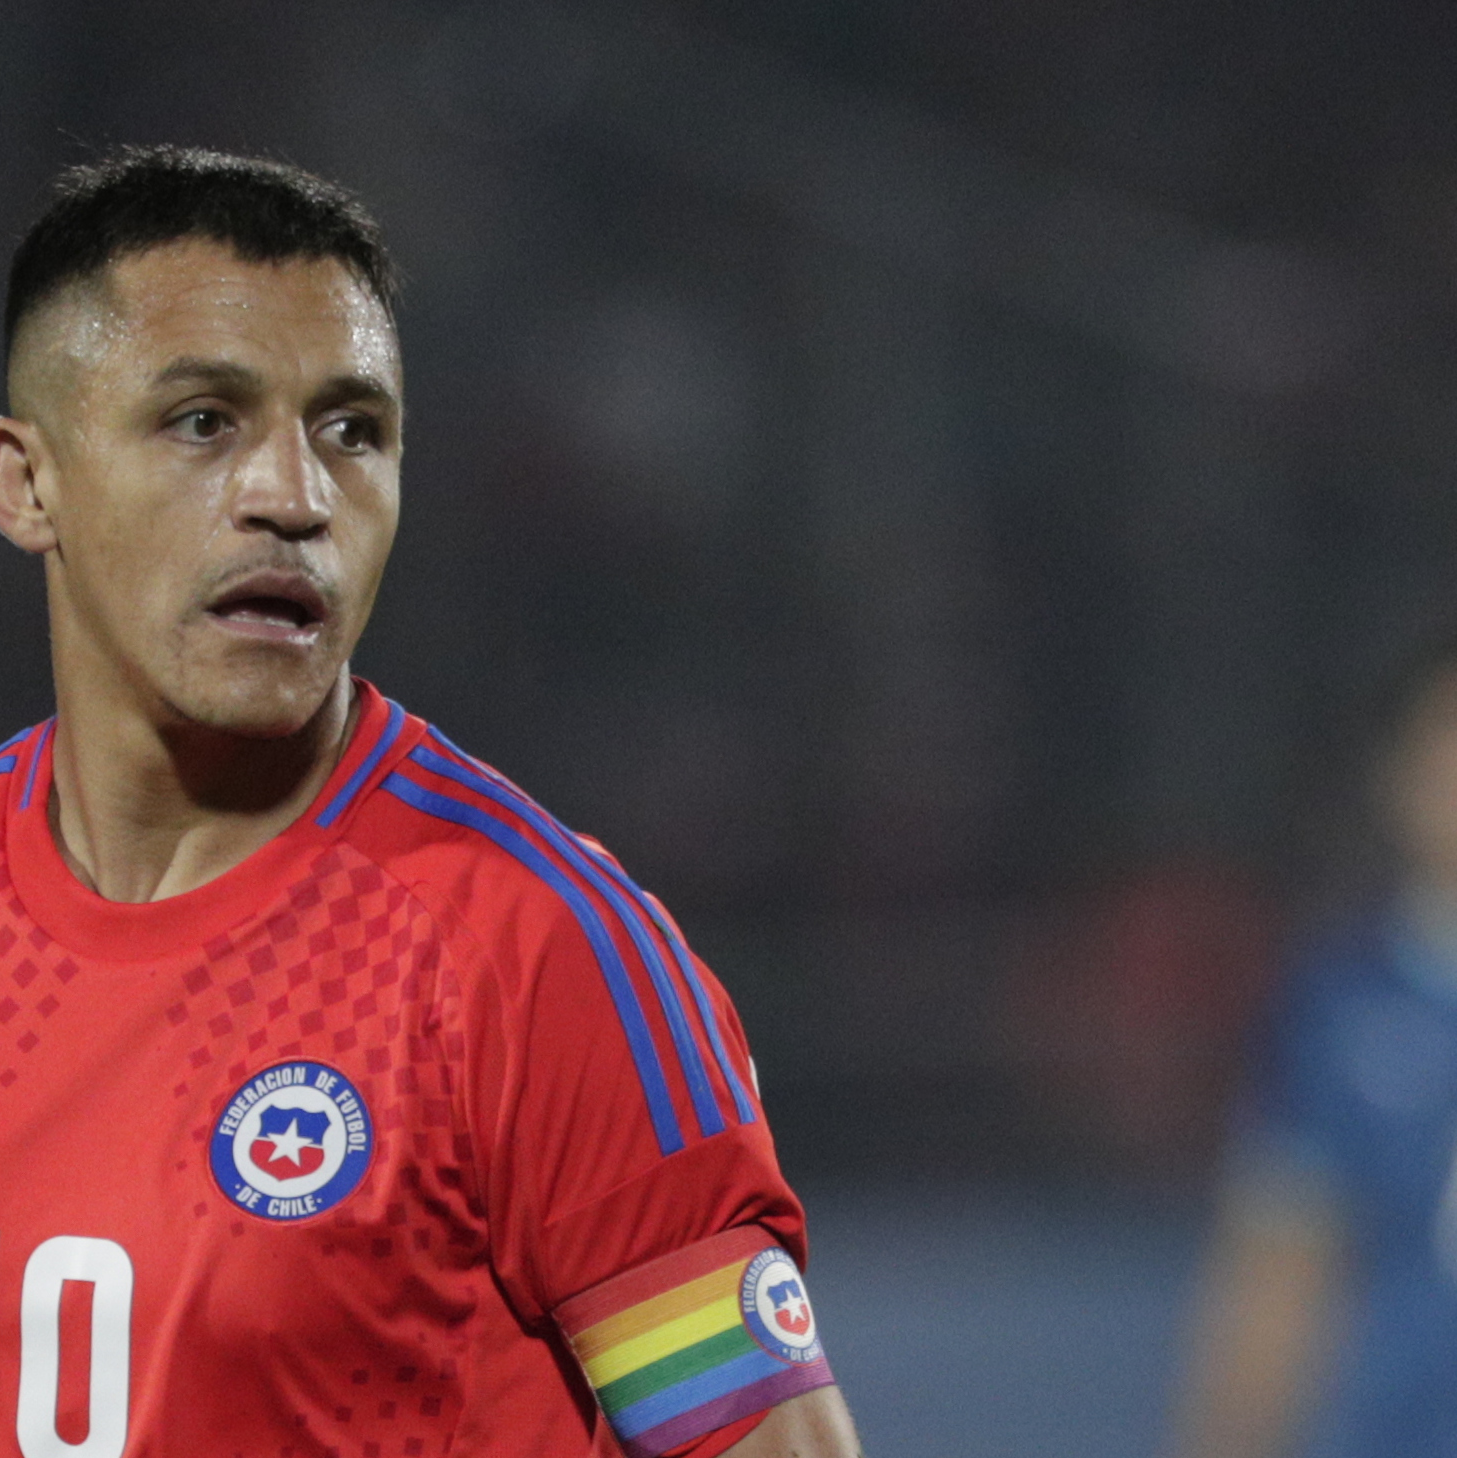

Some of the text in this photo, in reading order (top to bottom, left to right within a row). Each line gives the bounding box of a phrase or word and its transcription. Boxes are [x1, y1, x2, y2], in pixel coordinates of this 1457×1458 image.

[219, 1067, 367, 1154] FEDERACION DE FUTBOL
[235, 1185, 317, 1217] DE CHILE
